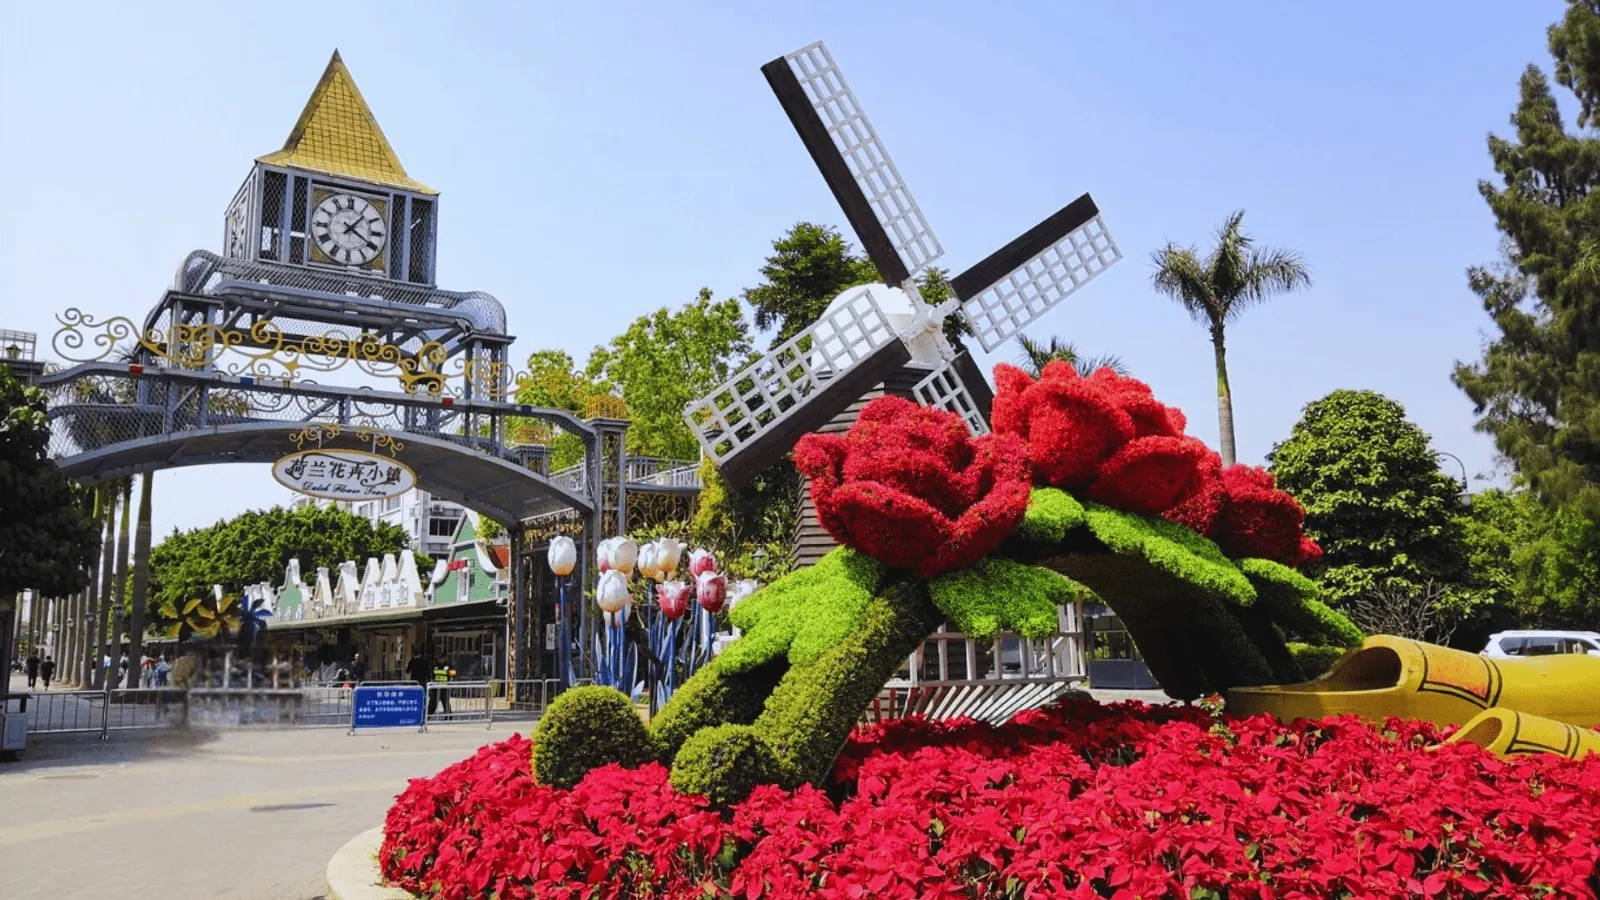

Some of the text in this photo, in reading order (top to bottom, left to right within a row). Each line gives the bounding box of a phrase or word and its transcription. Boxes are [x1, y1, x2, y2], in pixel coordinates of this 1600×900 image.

[286, 459, 403, 483] 荷兰花卉小镇
[332, 484, 360, 495] Flower
[364, 485, 387, 496] Town
